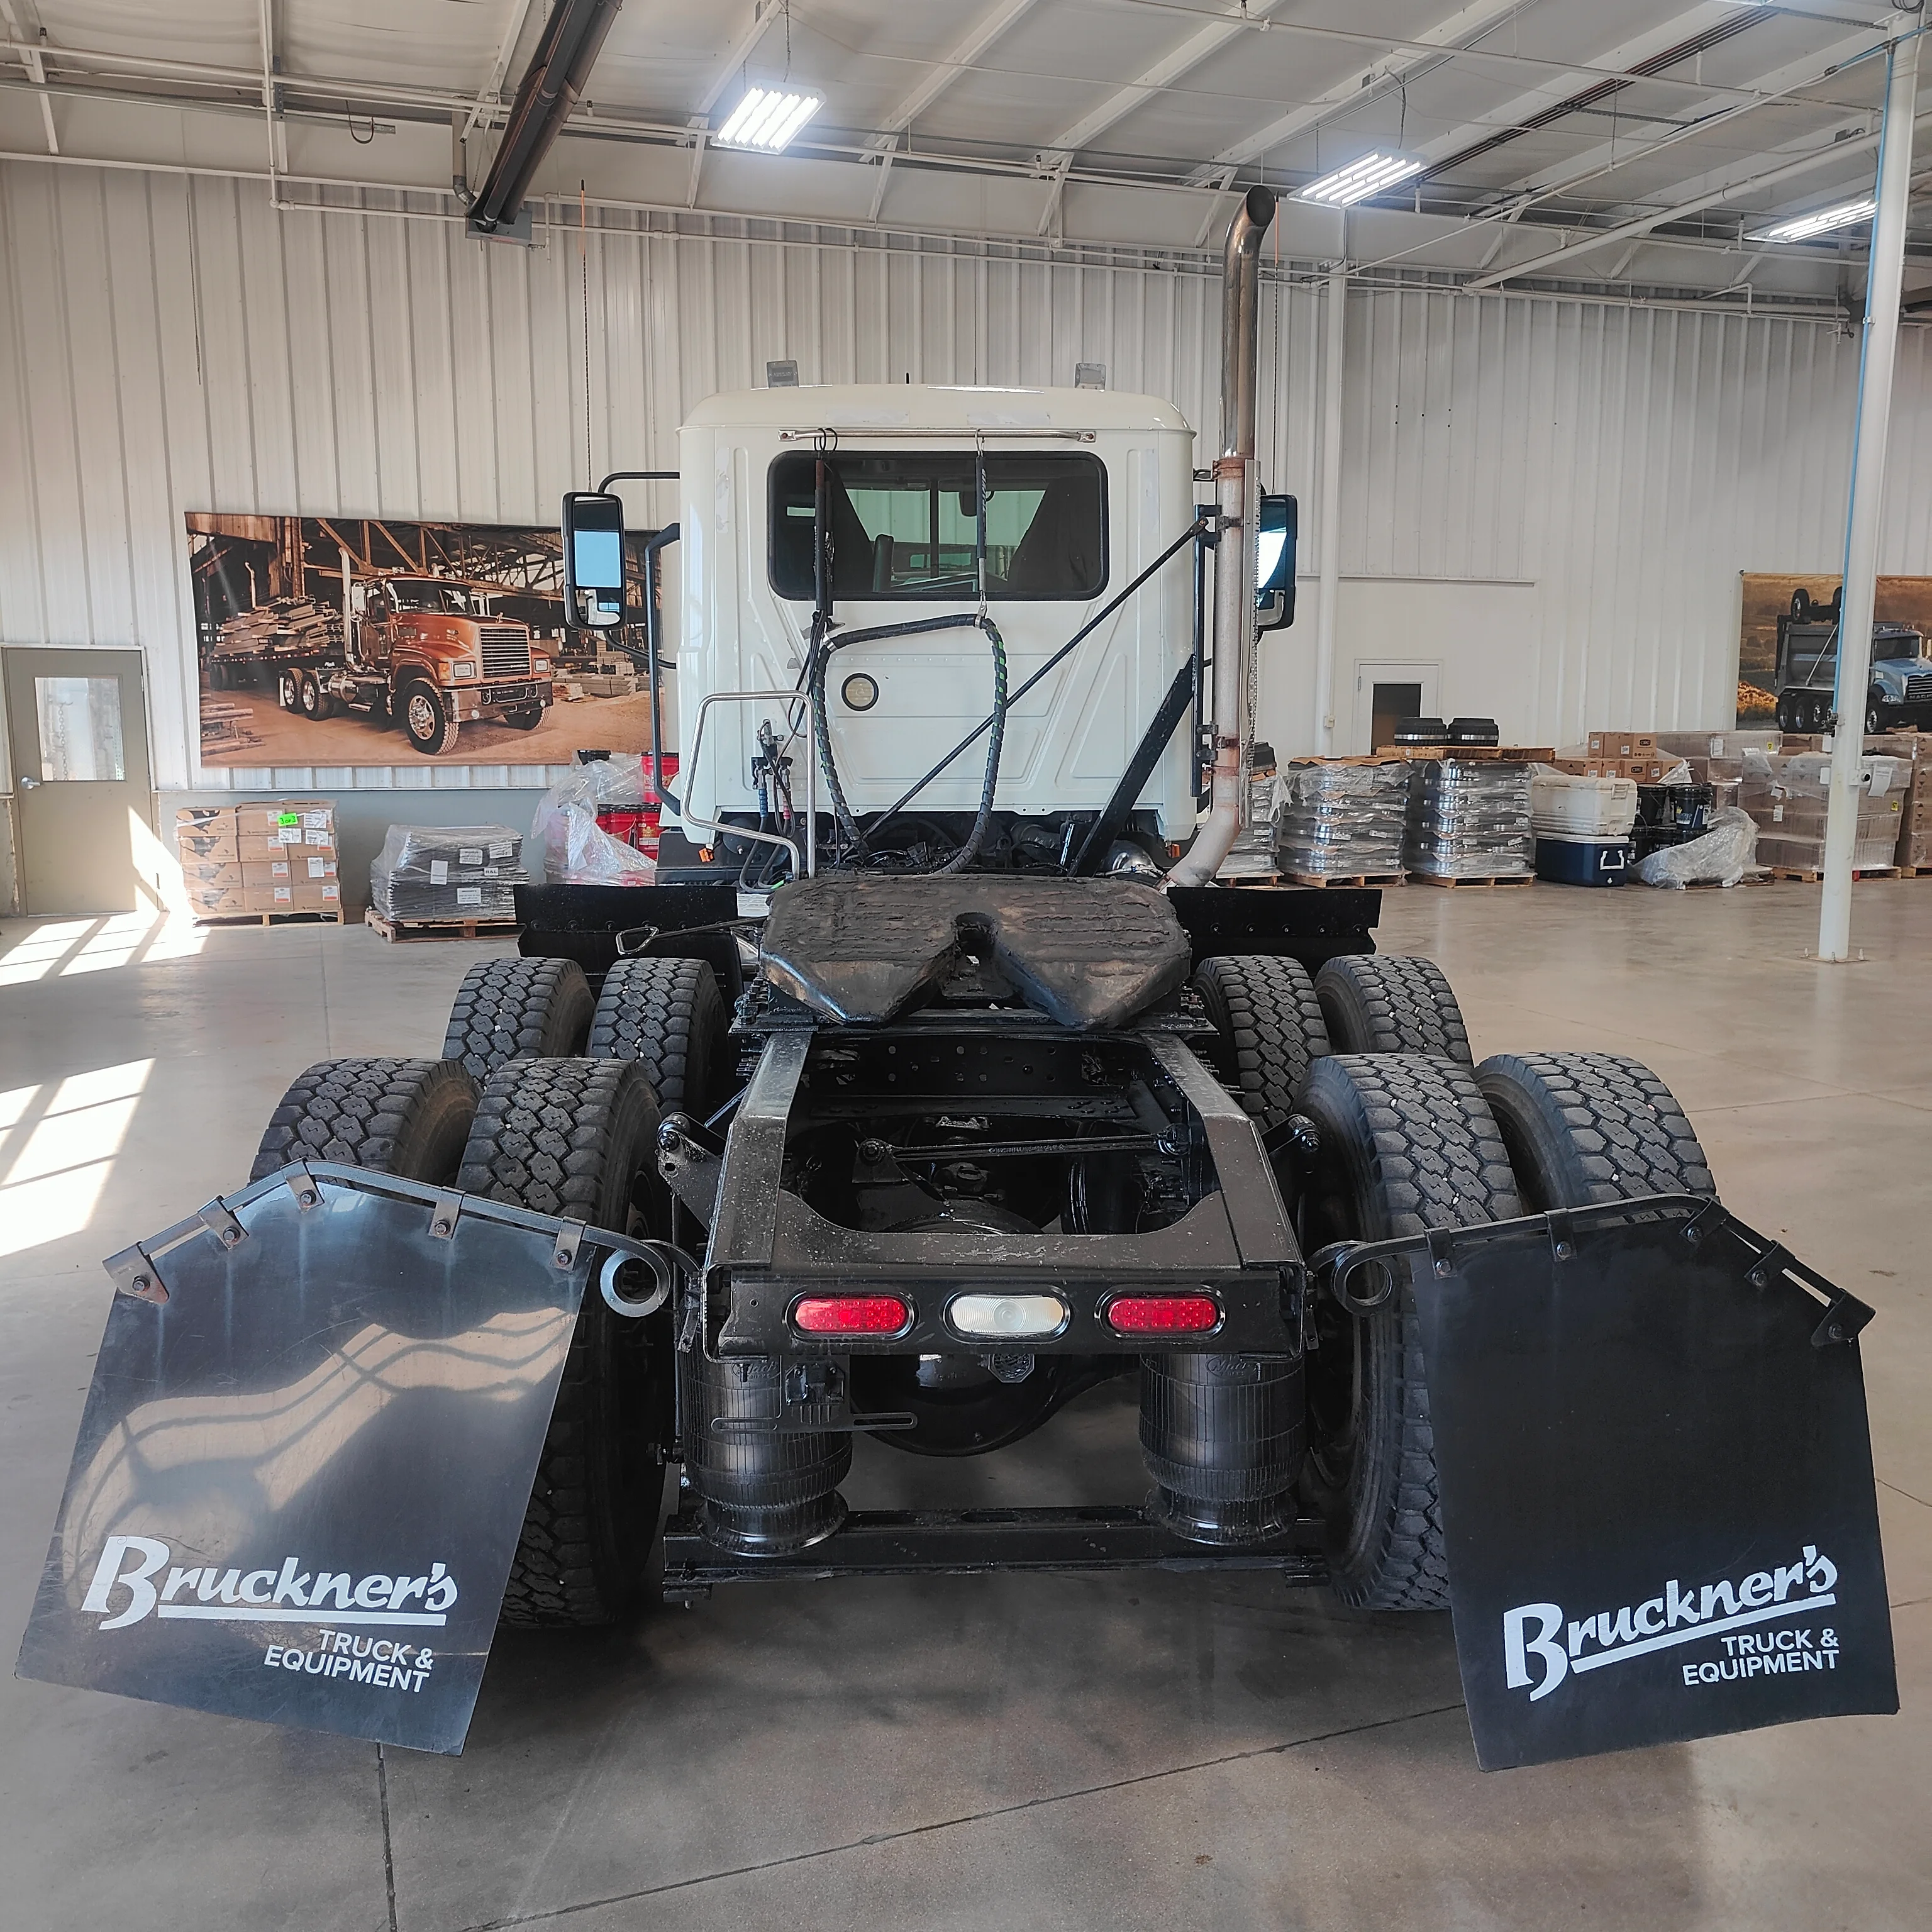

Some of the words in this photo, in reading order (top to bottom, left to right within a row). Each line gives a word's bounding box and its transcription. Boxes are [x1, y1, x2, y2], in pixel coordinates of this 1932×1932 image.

[80, 1536, 458, 1630] Bruckner's
[1503, 1545, 1838, 1702] Bruckner's
[1721, 1629, 1813, 1657] TRUCK
[1820, 1628, 1839, 1647] &
[264, 1644, 430, 1692] EQUIPMENT
[319, 1629, 412, 1665] TRUCK
[415, 1648, 434, 1670] &
[1682, 1650, 1840, 1685] EQUIPMENT
